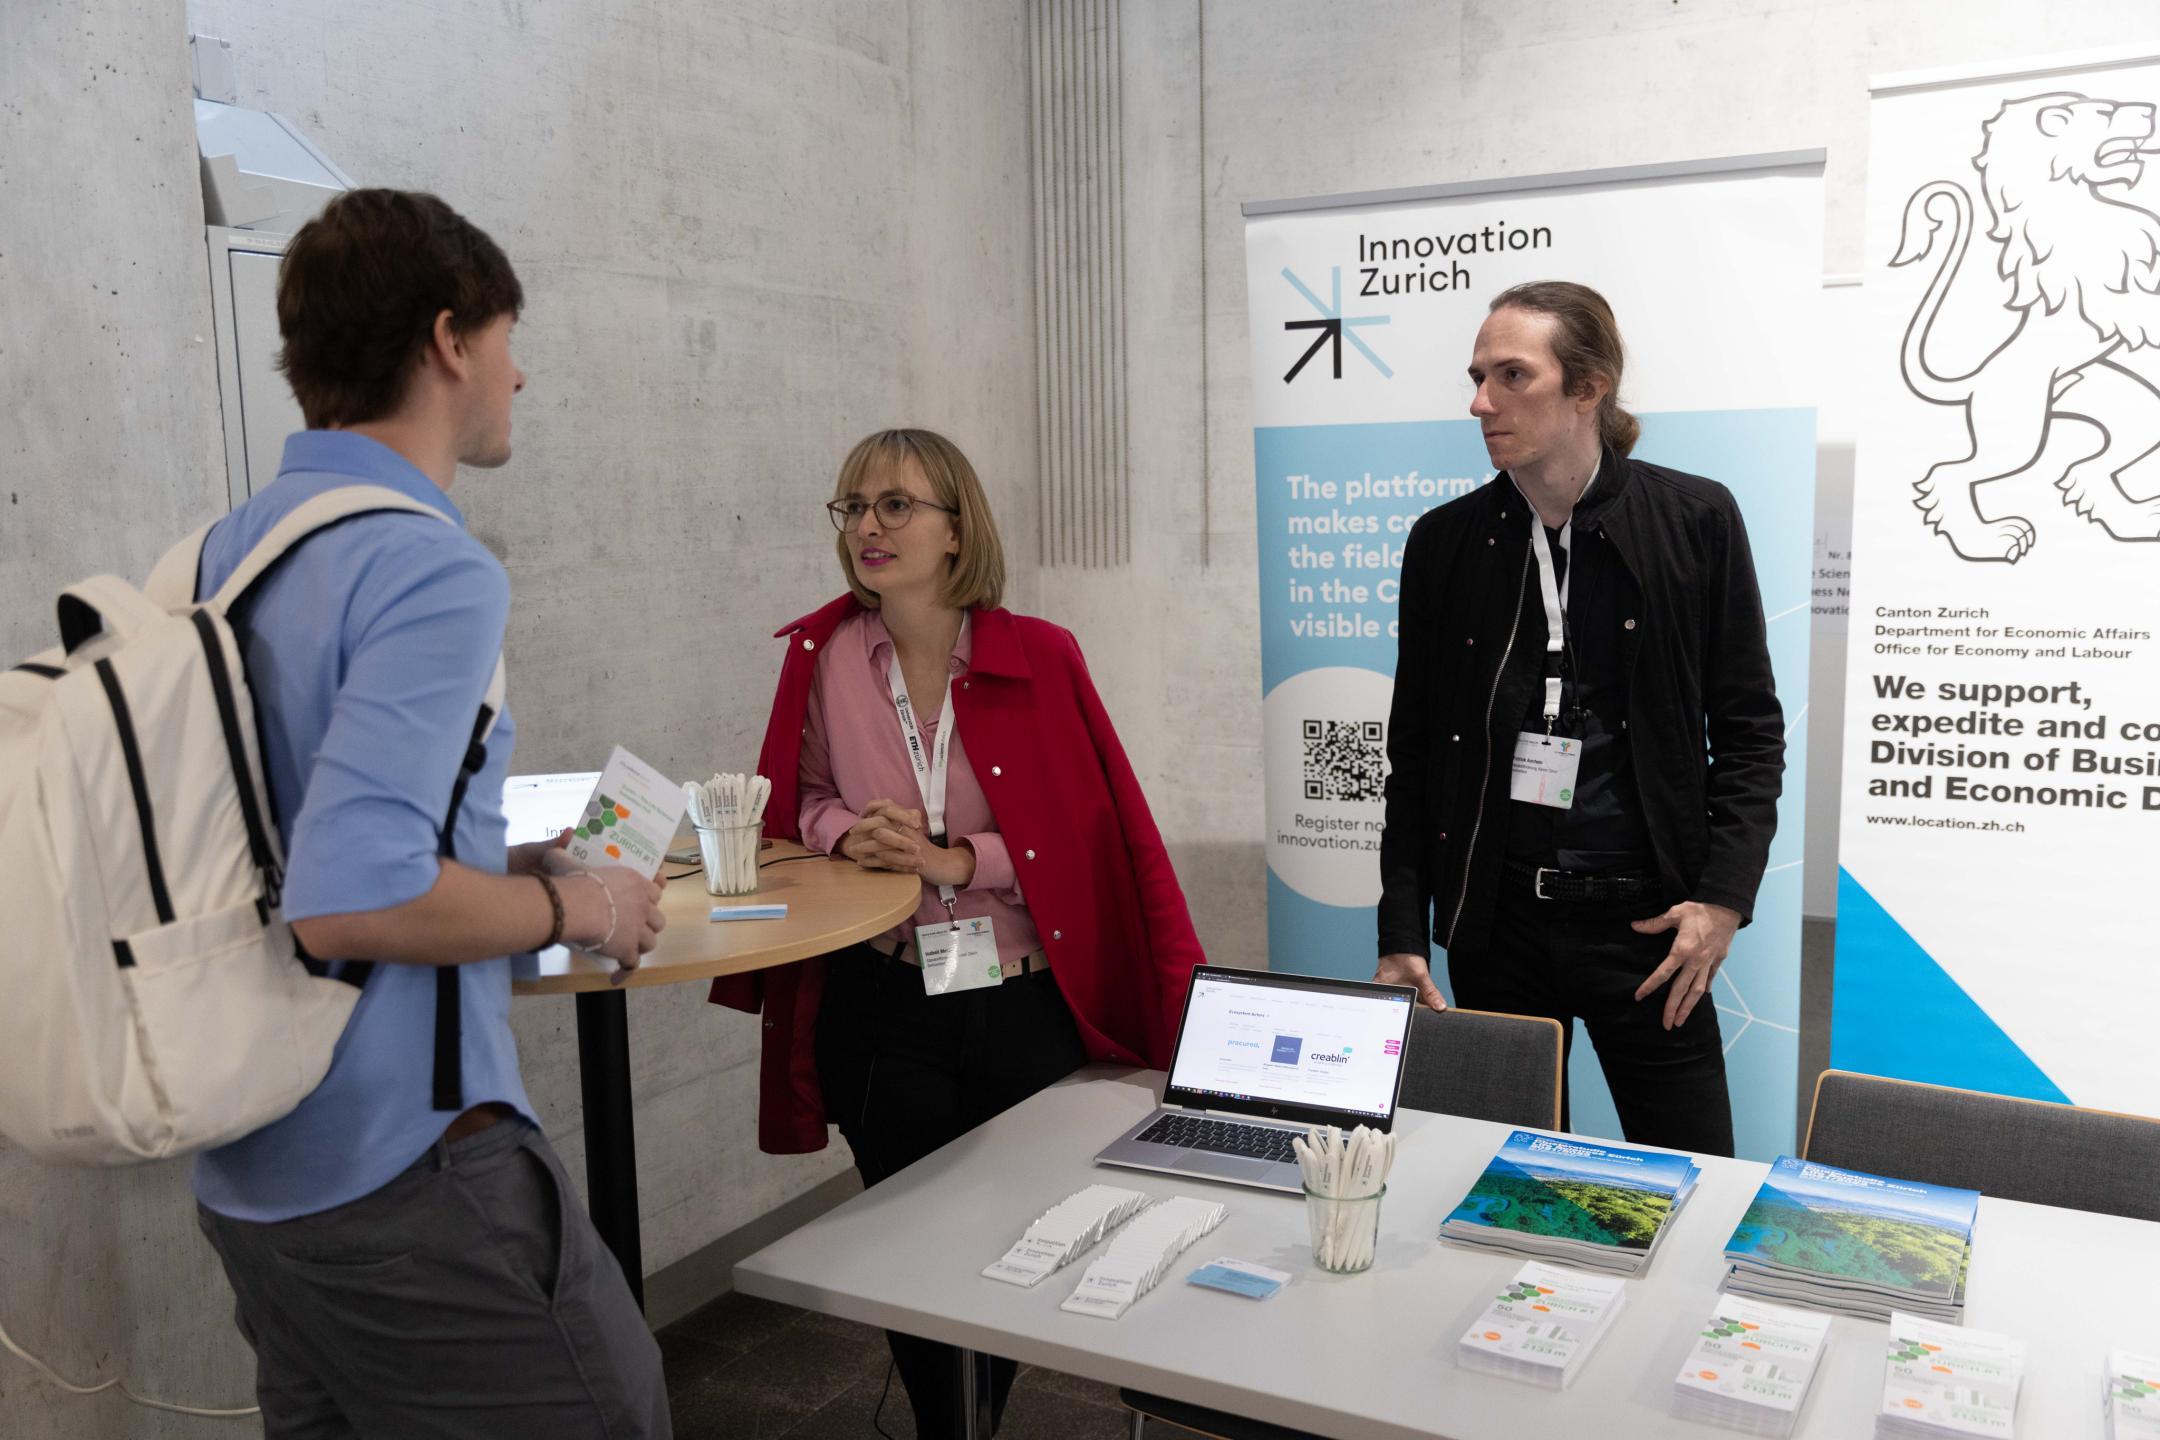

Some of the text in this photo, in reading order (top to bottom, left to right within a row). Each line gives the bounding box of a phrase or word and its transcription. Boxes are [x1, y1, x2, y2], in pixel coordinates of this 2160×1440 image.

[1359, 221, 1552, 263] Innovation
[1359, 260, 1471, 297] Zurich
[1286, 470, 1475, 505] The platform
[1287, 508, 1380, 535] makes
[1288, 543, 1336, 569] the
[1289, 578, 1314, 603] in
[1319, 578, 1369, 603] the
[1290, 612, 1381, 638] visible
[1876, 606, 1990, 619] Canton Zurich
[1874, 624, 2151, 641] Department for Economic Affairs
[1874, 642, 2133, 660] Office for Economy and Labour
[1872, 674, 2092, 710] We support,
[1871, 710, 2024, 738] expedite
[2036, 714, 2106, 740] and
[1870, 740, 2160, 777] Division of Busi
[1868, 775, 1933, 799] and
[1945, 776, 2128, 810] Economic
[1295, 813, 1360, 833] Register
[1866, 813, 2026, 834] www.location.zh.ch
[572, 845, 588, 861] 50
